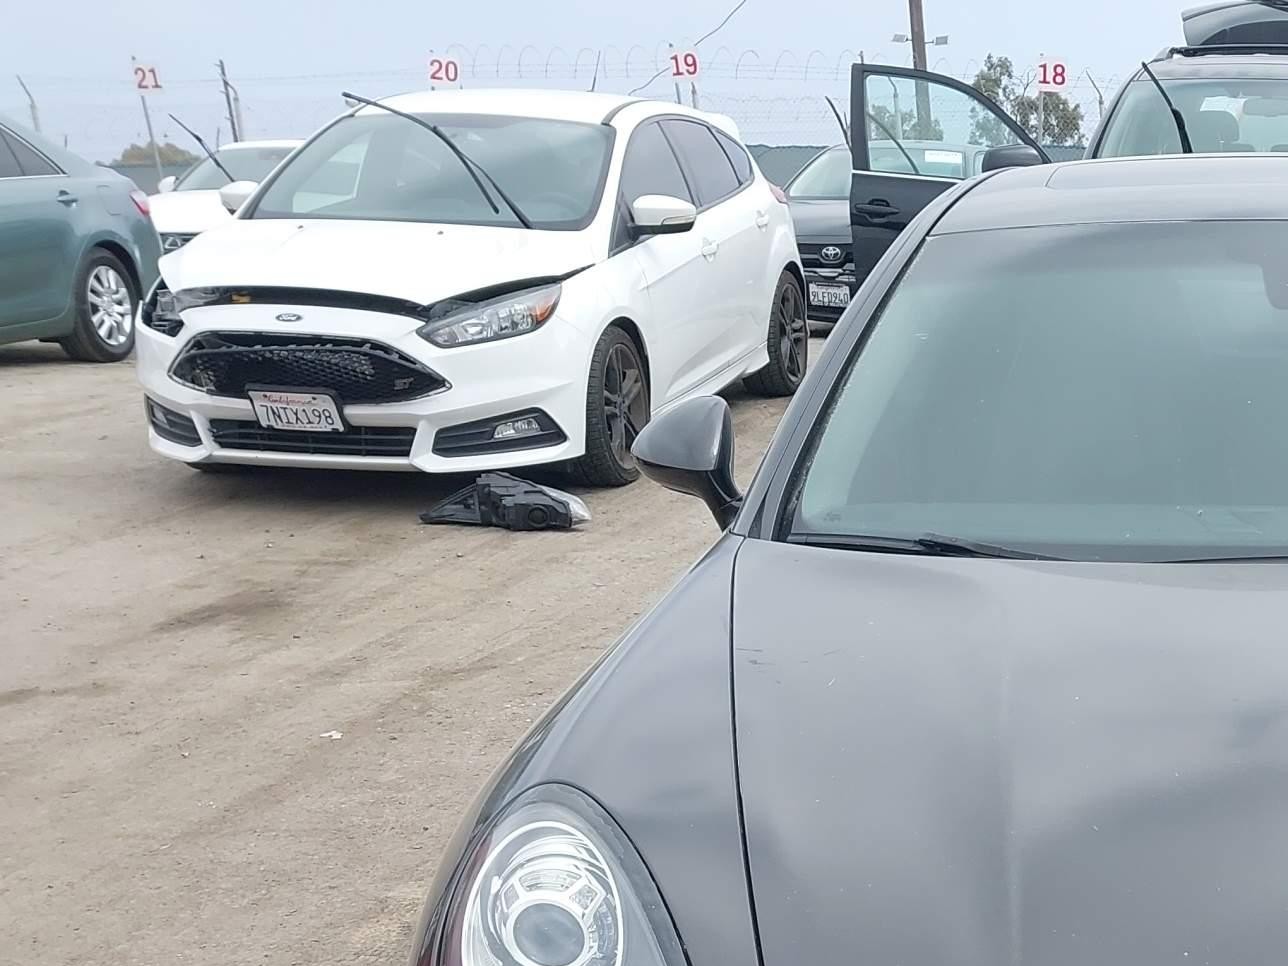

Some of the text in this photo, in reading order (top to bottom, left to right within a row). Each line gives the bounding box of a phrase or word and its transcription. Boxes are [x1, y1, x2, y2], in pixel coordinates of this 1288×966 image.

[430, 59, 458, 82] 20
[670, 53, 697, 76] 19
[1038, 63, 1066, 86] 18
[134, 67, 163, 89] 21
[259, 404, 335, 426] 7NIX198
